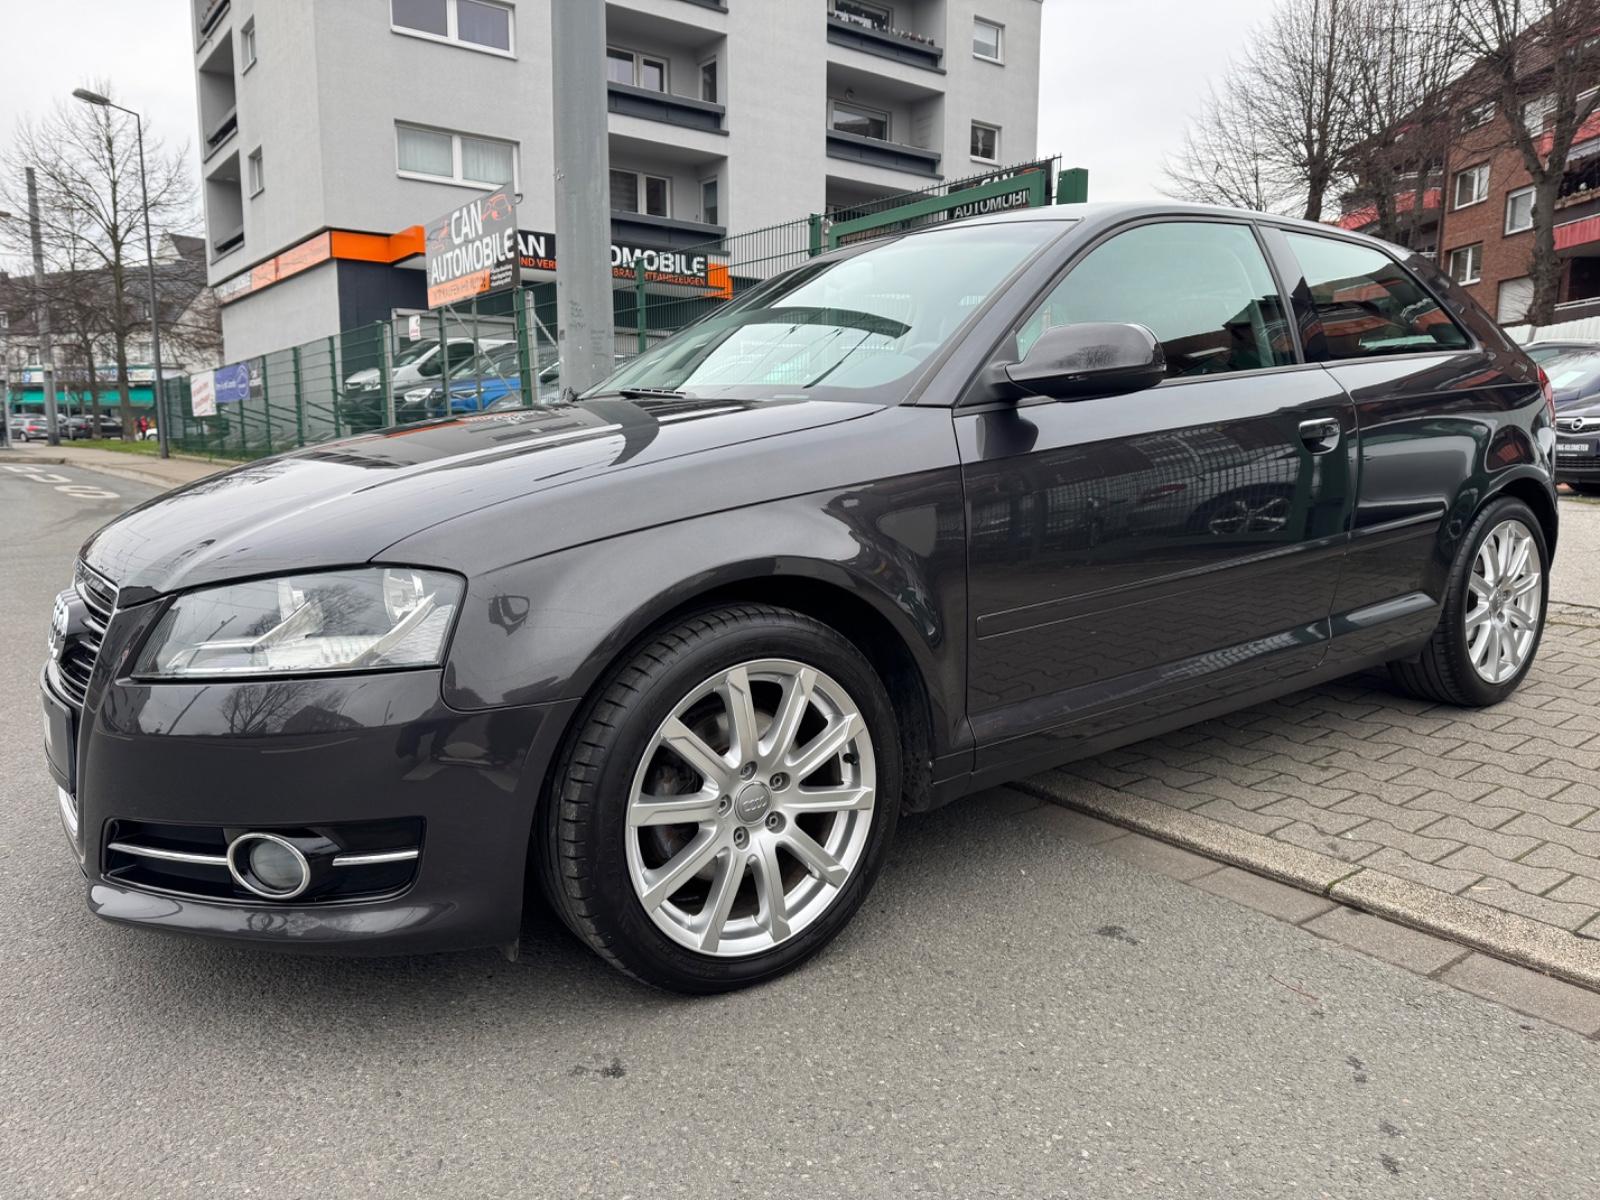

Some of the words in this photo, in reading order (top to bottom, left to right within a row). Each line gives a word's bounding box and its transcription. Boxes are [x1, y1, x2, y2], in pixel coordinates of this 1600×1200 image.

[451, 200, 483, 245] CAN
[954, 189, 1030, 217] AUTOMOBI
[431, 227, 515, 286] AUTOMOBILE
[517, 233, 545, 258] AN
[611, 245, 706, 277] OMOBILE
[519, 256, 535, 267] ND
[536, 258, 556, 269] VER
